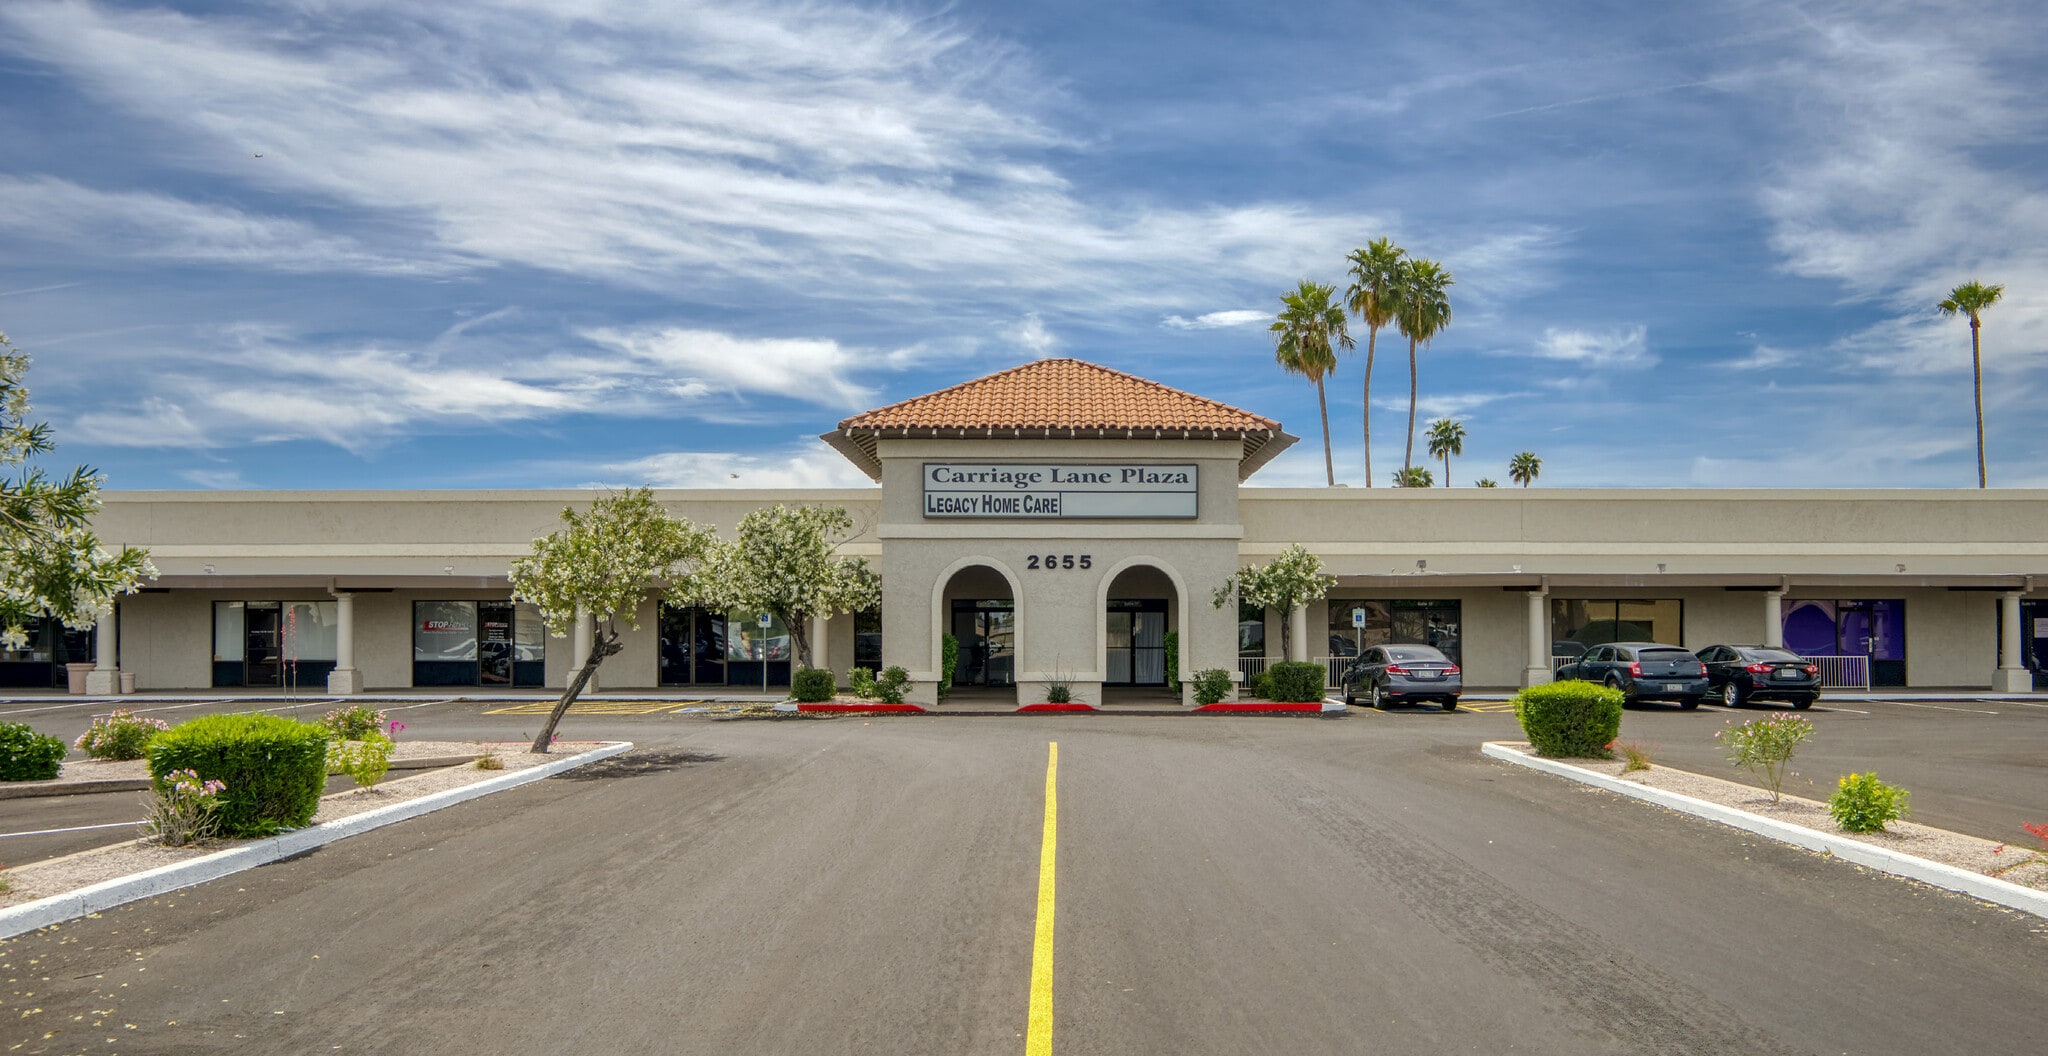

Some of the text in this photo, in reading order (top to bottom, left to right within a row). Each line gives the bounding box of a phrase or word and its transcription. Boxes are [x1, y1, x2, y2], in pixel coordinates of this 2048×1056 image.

[931, 467, 1190, 489] Carriage Lane Plaza
[927, 494, 1058, 514] LEGACY HOME CARE
[1026, 555, 1093, 570] 2655
